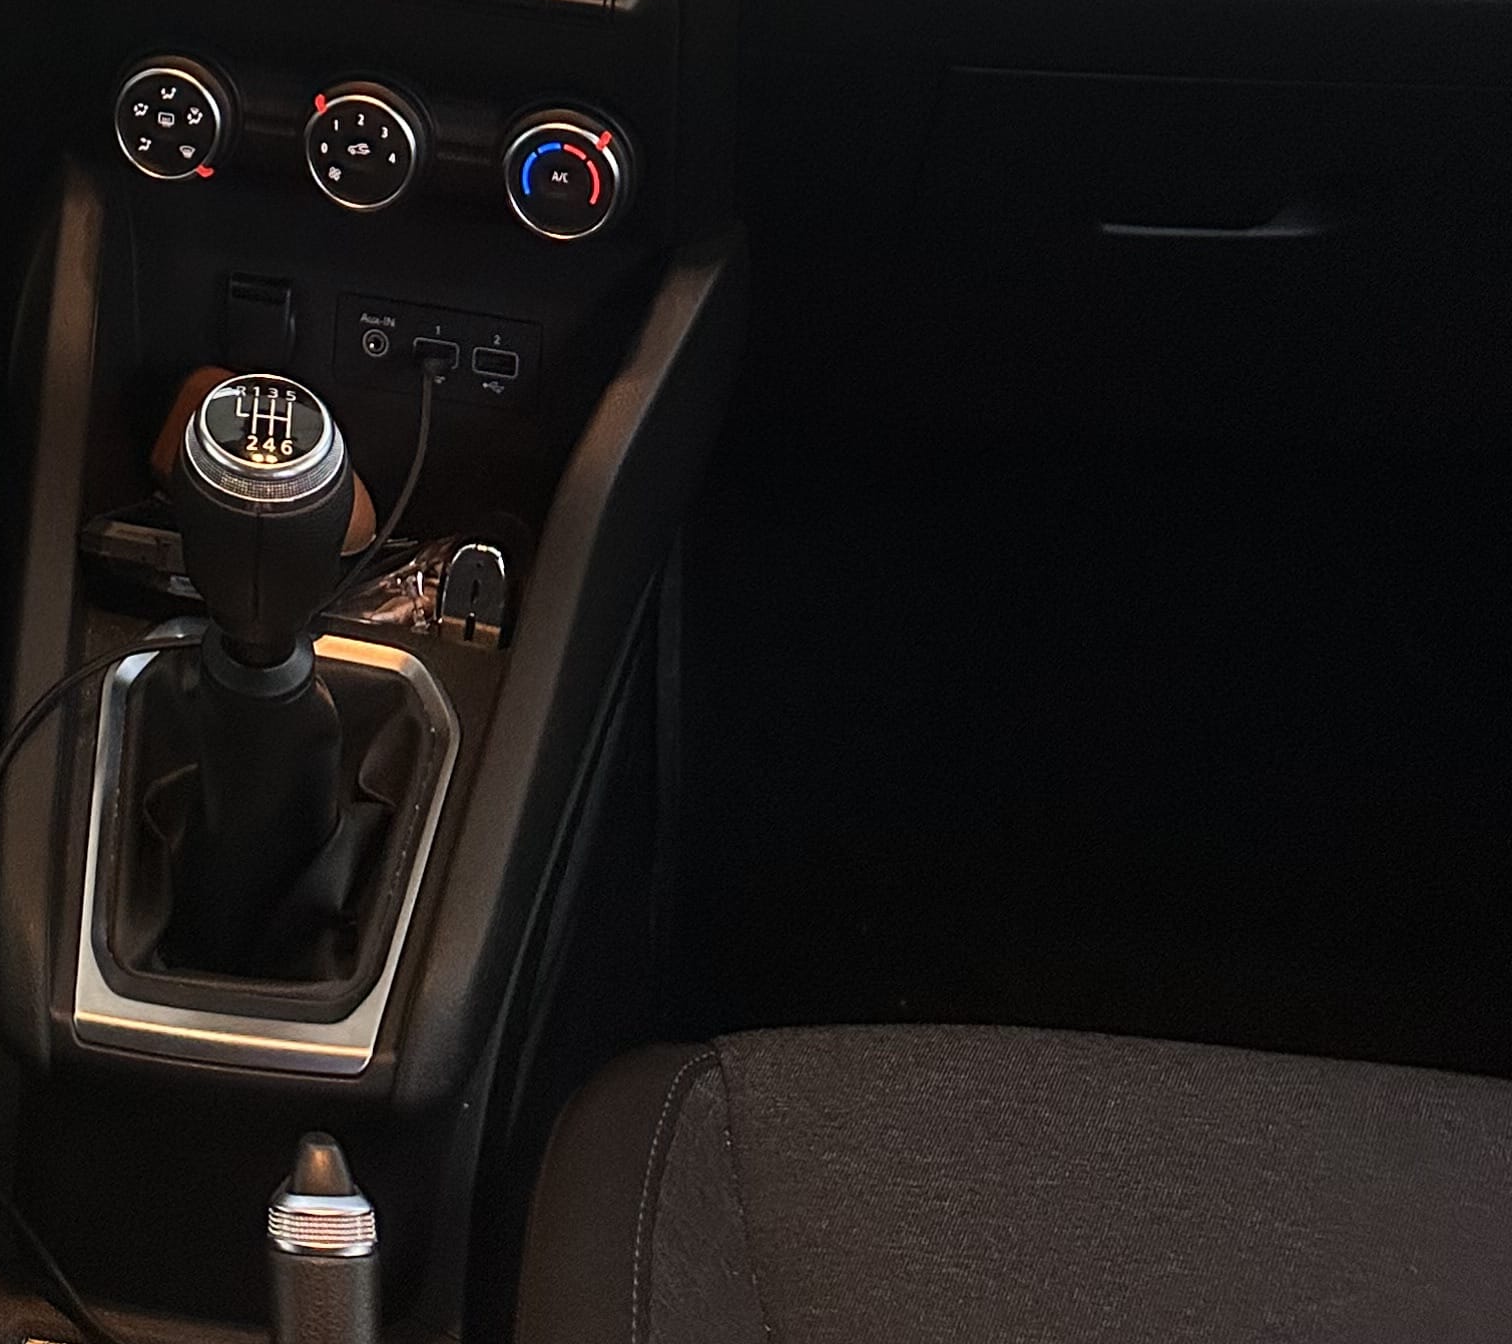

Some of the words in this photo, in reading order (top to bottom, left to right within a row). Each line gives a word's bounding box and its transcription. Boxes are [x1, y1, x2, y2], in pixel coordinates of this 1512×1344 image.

[357, 113, 364, 126] 2
[381, 126, 388, 139] 3
[321, 142, 328, 154] 0
[388, 152, 396, 164] 4
[551, 170, 568, 184] A/C
[253, 386, 261, 397] 1
[268, 388, 279, 399] 3
[286, 390, 297, 401] 5
[246, 435, 258, 451] 2
[263, 437, 276, 452] 4
[280, 439, 293, 455] 6
